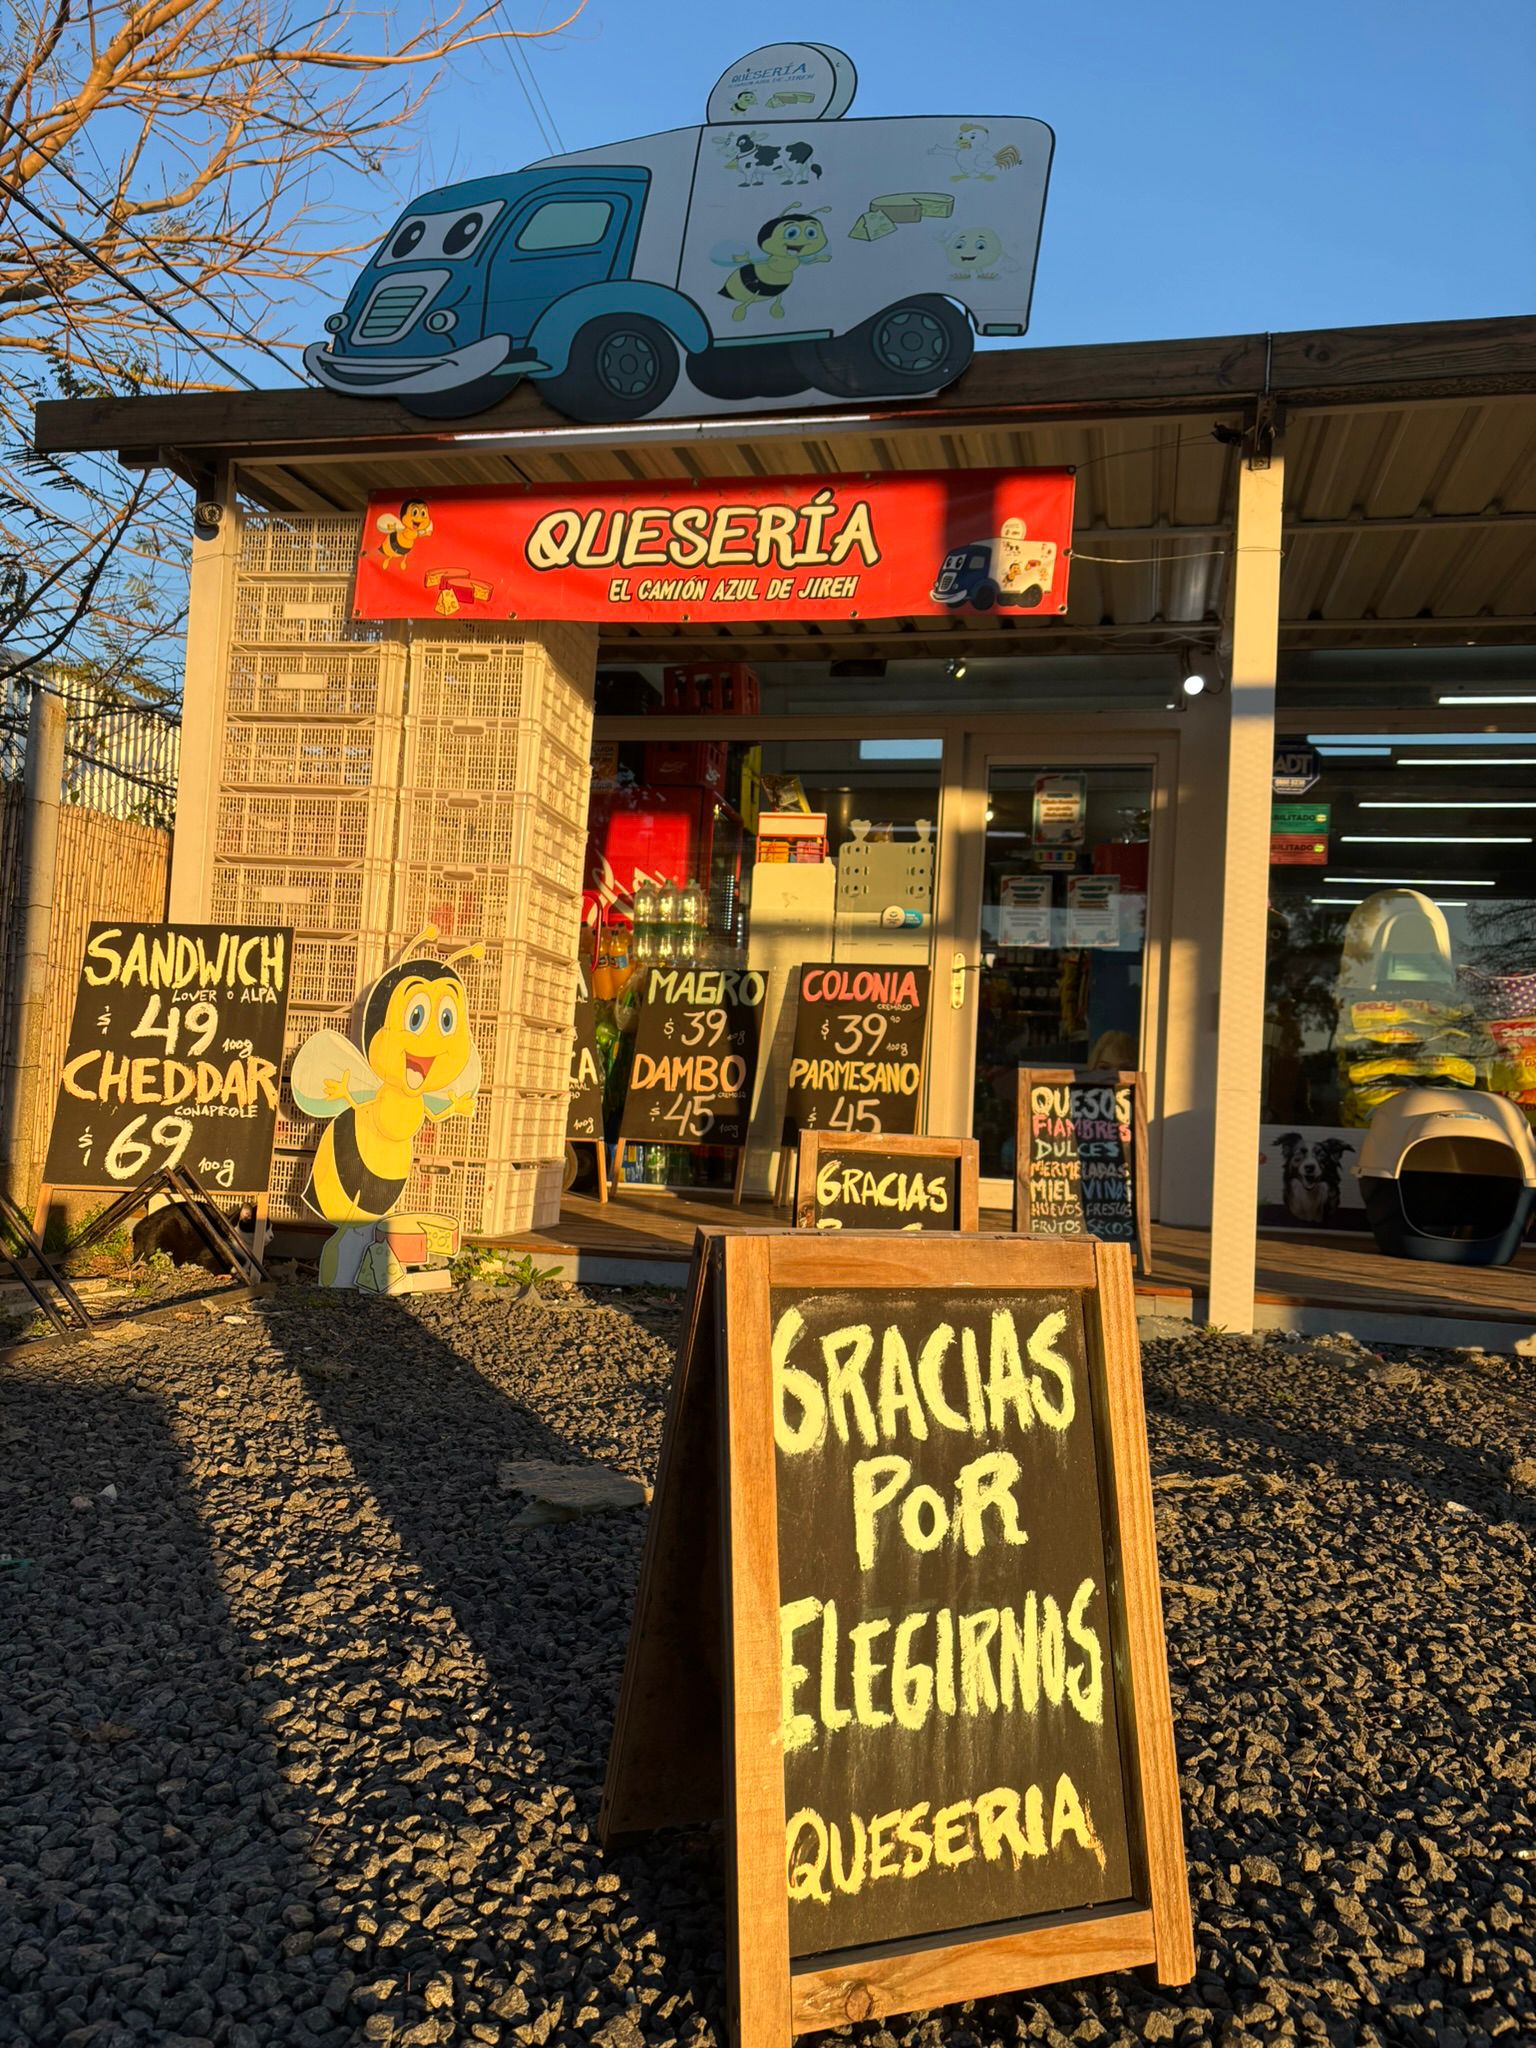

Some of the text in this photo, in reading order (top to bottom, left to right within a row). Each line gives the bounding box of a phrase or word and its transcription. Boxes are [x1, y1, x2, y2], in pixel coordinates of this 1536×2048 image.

[524, 487, 881, 571] QUESERÍA
[609, 575, 860, 602] EL CAMIÓN AZUL DE JIREH
[1274, 753, 1313, 774] ADT
[84, 929, 284, 991] SANDWICH
[648, 969, 765, 1006] MAGRO
[802, 969, 920, 1008] COLONIA
[131, 994, 219, 1056] 49
[681, 1008, 728, 1047] 39
[834, 1012, 887, 1056] 39
[62, 1050, 278, 1111] CHEDDAR
[631, 1053, 747, 1093] DAMBO
[789, 1058, 920, 1096] PARMESANO
[174, 1104, 258, 1118] CONAPROLE
[663, 1093, 716, 1137] 45
[828, 1096, 882, 1132] 45
[1031, 1086, 1131, 1126] QUESOS
[1032, 1113, 1132, 1142] FIAMBRES
[104, 1114, 194, 1181] 69
[1034, 1138, 1119, 1160] DULCES
[816, 1160, 948, 1213] GRACIAS
[1030, 1160, 1130, 1181] MERMELADAS
[1030, 1200, 1084, 1218] HUEVOS
[1031, 1218, 1134, 1236] FRUTOS SECOS
[771, 1304, 1076, 1455] GRACIAS
[779, 1577, 1104, 1754] ELEGIRNOS
[786, 1772, 1106, 1906] QUESERIA
